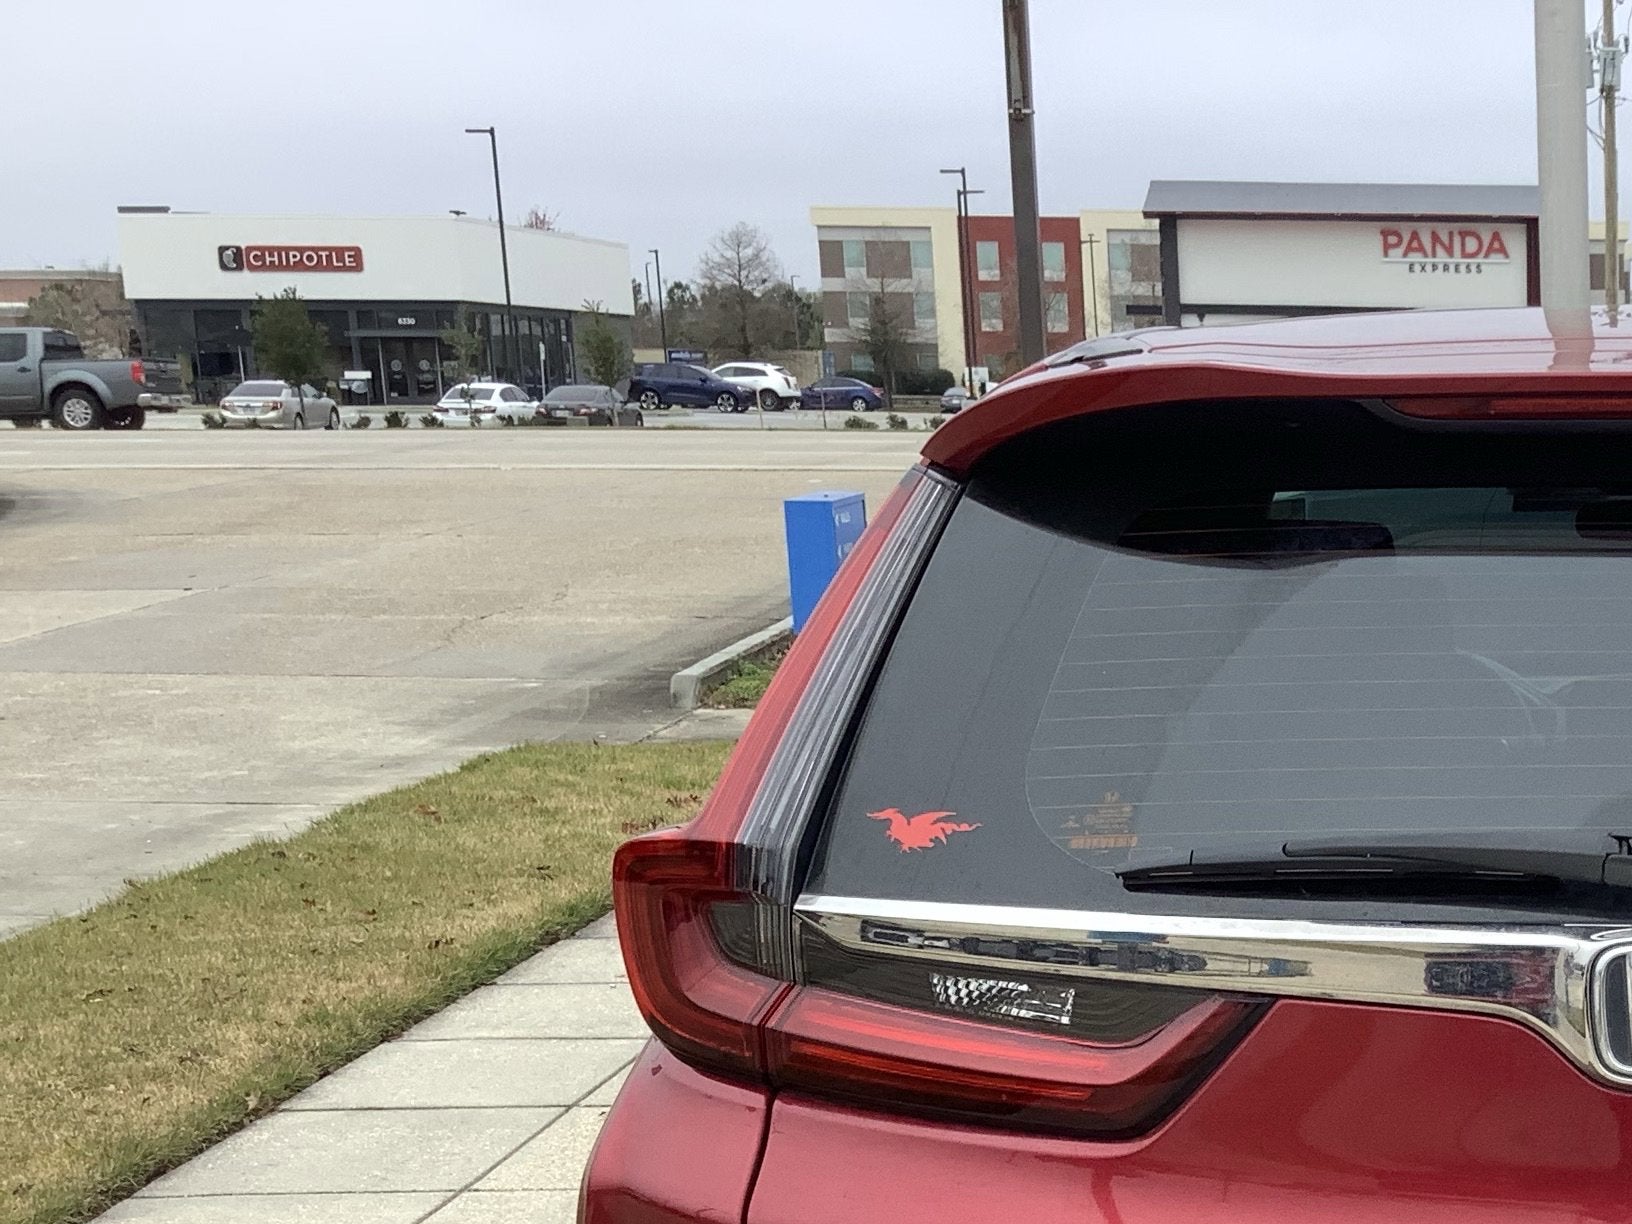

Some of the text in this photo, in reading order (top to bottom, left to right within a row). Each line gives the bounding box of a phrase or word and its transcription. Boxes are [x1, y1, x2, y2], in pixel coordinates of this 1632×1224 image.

[1380, 228, 1510, 259] PANDA
[249, 251, 357, 266] CHIPOTLE
[1408, 263, 1482, 273] EXPRESS
